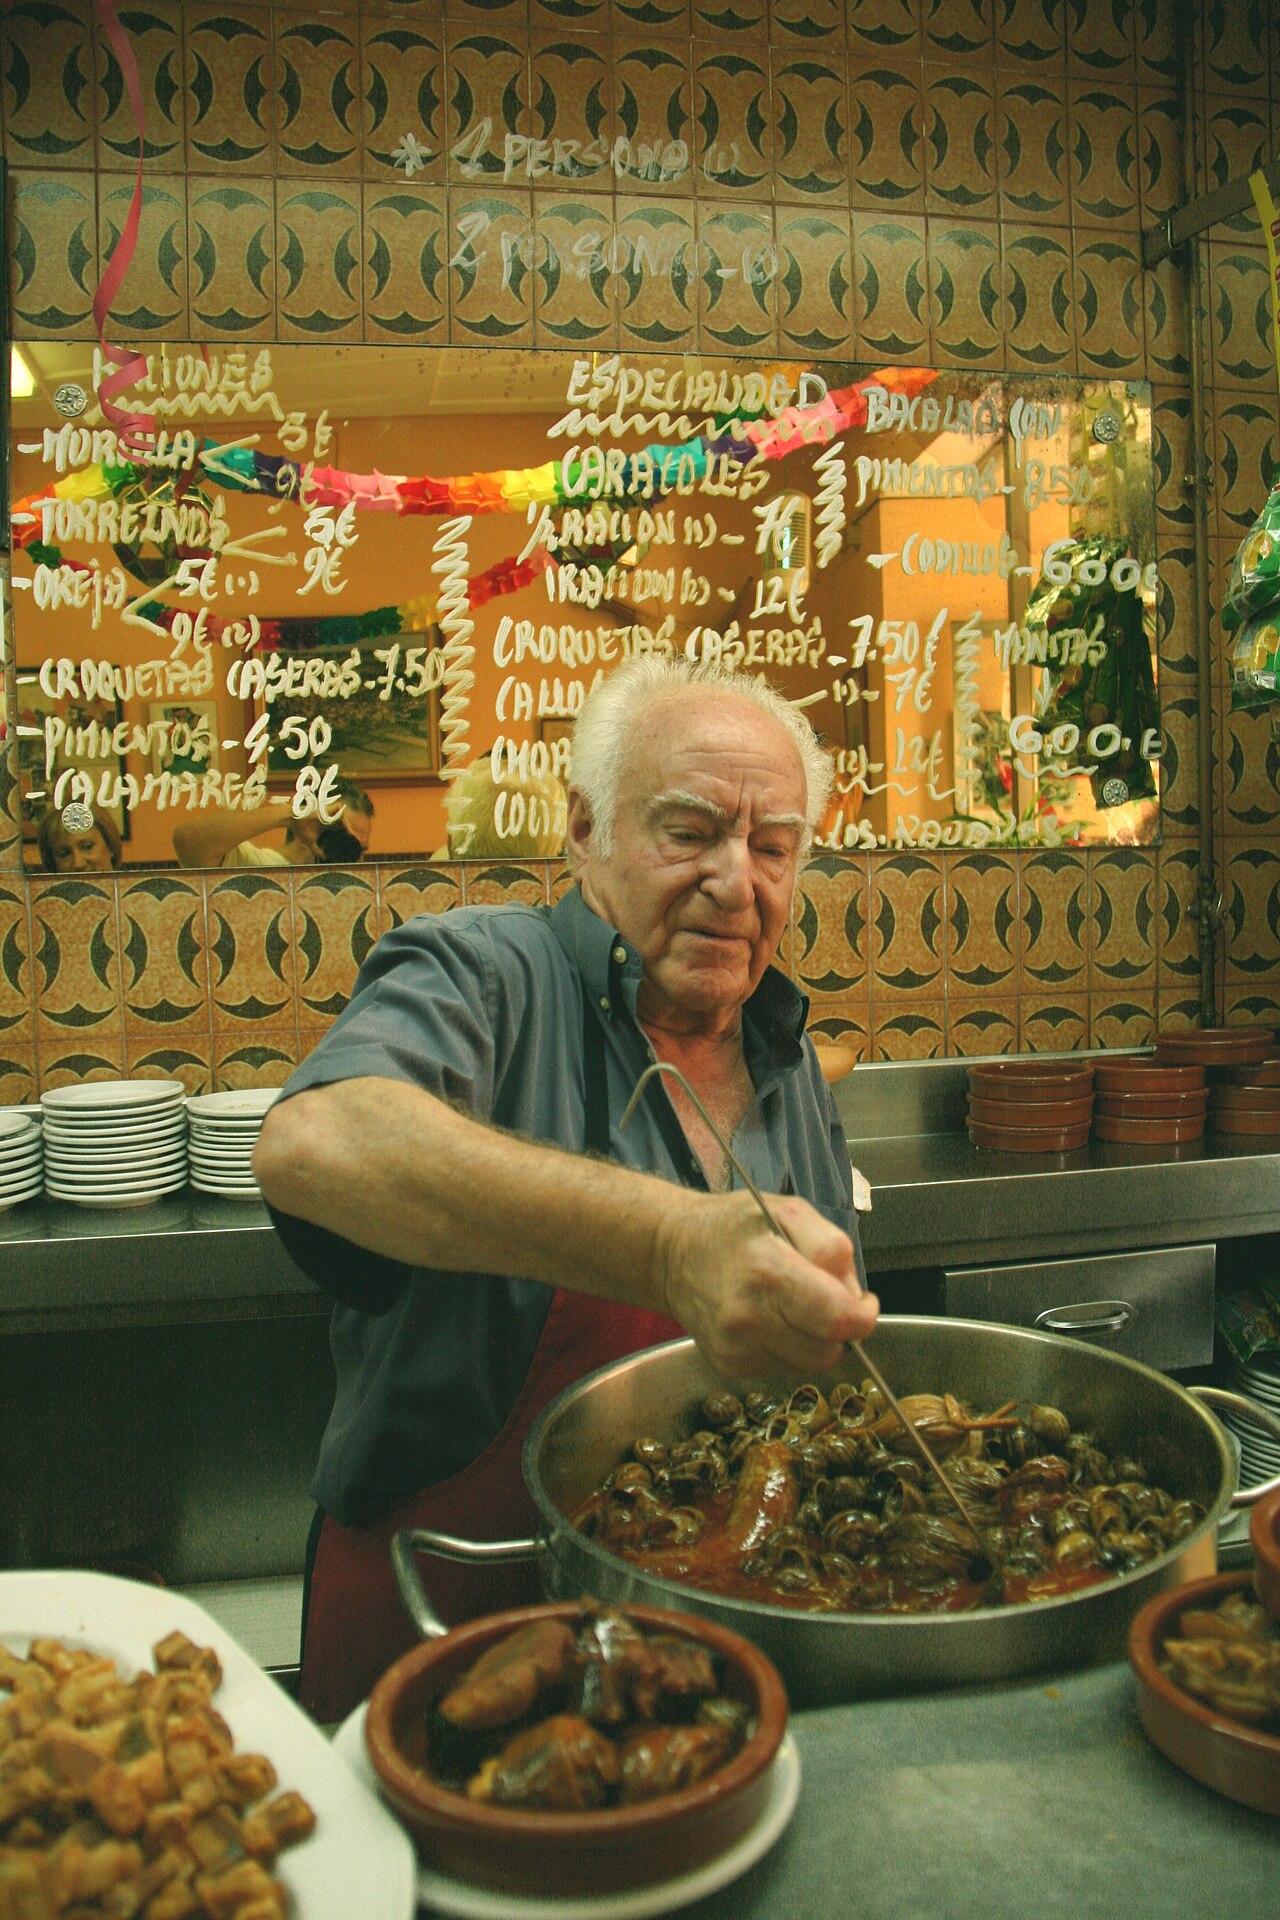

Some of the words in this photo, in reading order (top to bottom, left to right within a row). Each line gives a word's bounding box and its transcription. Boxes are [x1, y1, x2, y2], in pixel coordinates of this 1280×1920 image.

[449, 211, 490, 273] 2
[565, 354, 829, 424] ESPECIALIDAD
[860, 385, 999, 435] BACALAO
[1008, 397, 1062, 445] CON
[562, 444, 771, 500] CARACOLES
[853, 454, 998, 507] PIMIENTOS
[558, 508, 676, 547] RACION
[558, 563, 676, 610] RACION
[493, 614, 678, 669] CROQUETAS
[994, 613, 1108, 673] MANITAS
[40, 646, 216, 700] CROQUETAS
[44, 714, 218, 780] PIMIENTOS
[54, 764, 269, 812] CALAMARES
